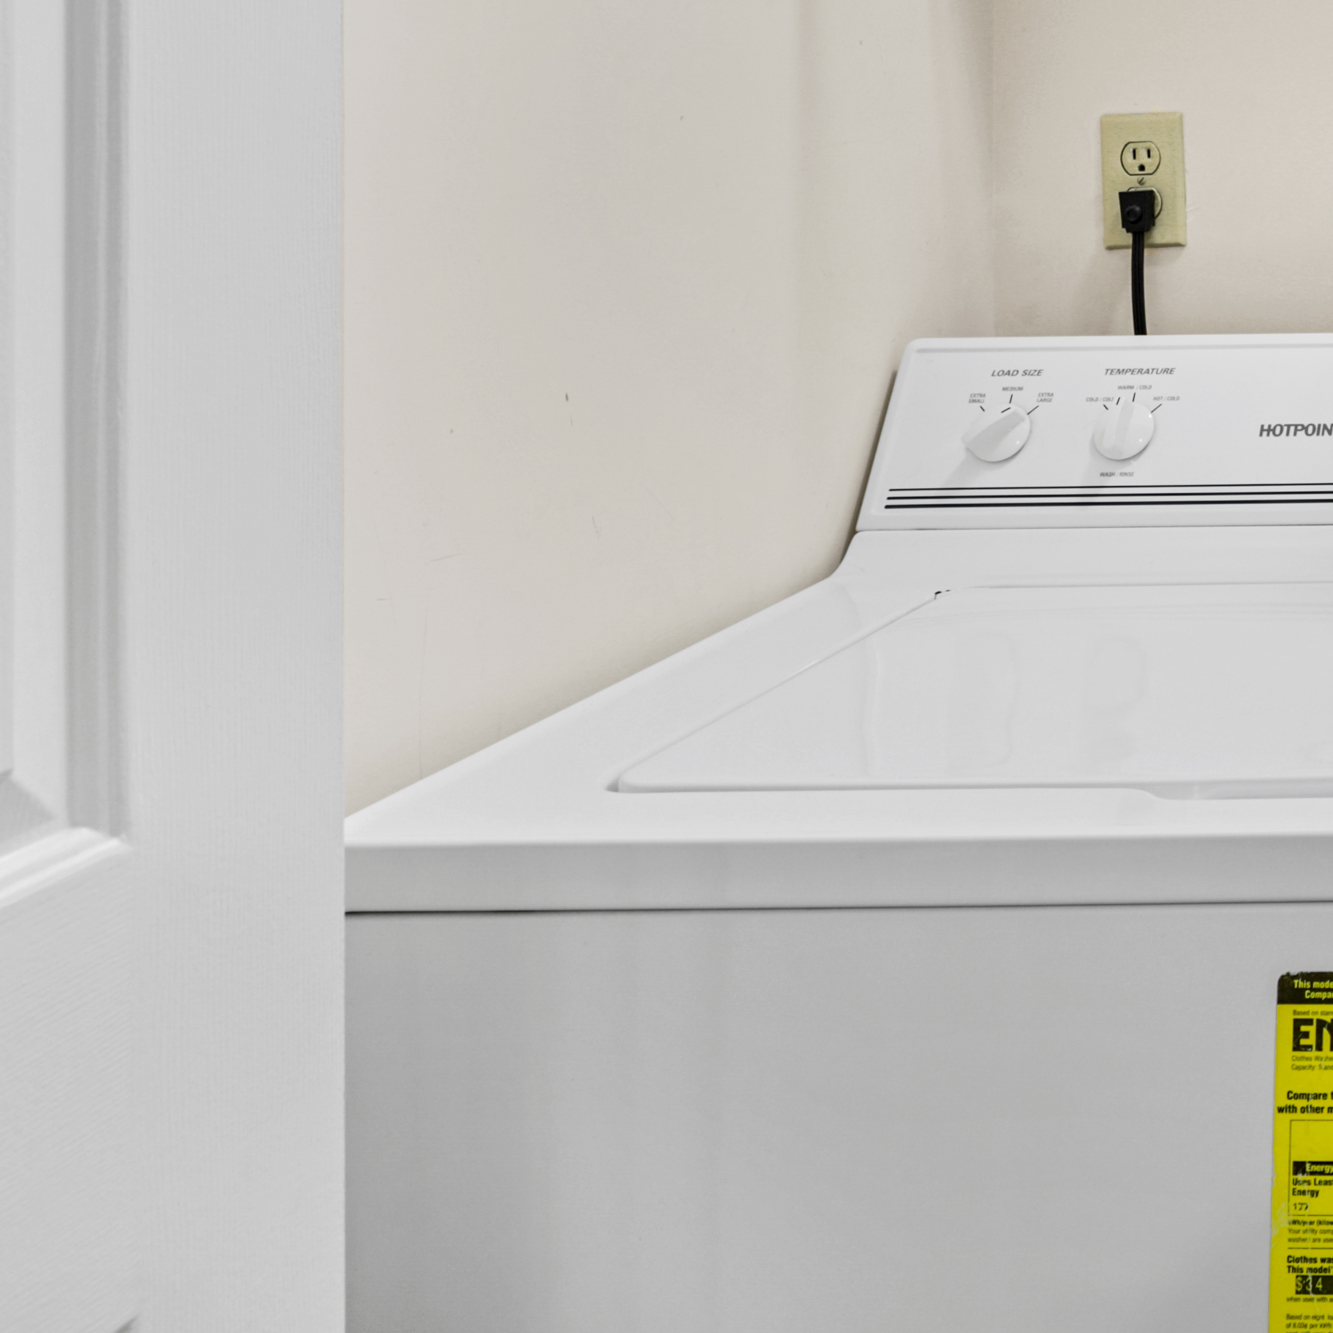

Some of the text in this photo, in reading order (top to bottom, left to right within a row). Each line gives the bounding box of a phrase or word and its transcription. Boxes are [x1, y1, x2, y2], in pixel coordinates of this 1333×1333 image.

[1104, 367, 1176, 376] TEMPERATURE
[1293, 979, 1311, 989] This
[1286, 1090, 1328, 1102] Compare
[1277, 1104, 1297, 1114] with
[1300, 1104, 1325, 1114] other
[1292, 1177, 1311, 1186] Uses
[1292, 1188, 1319, 1198] Energy
[1287, 1255, 1318, 1264] Clothes
[1287, 1265, 1304, 1274] This
